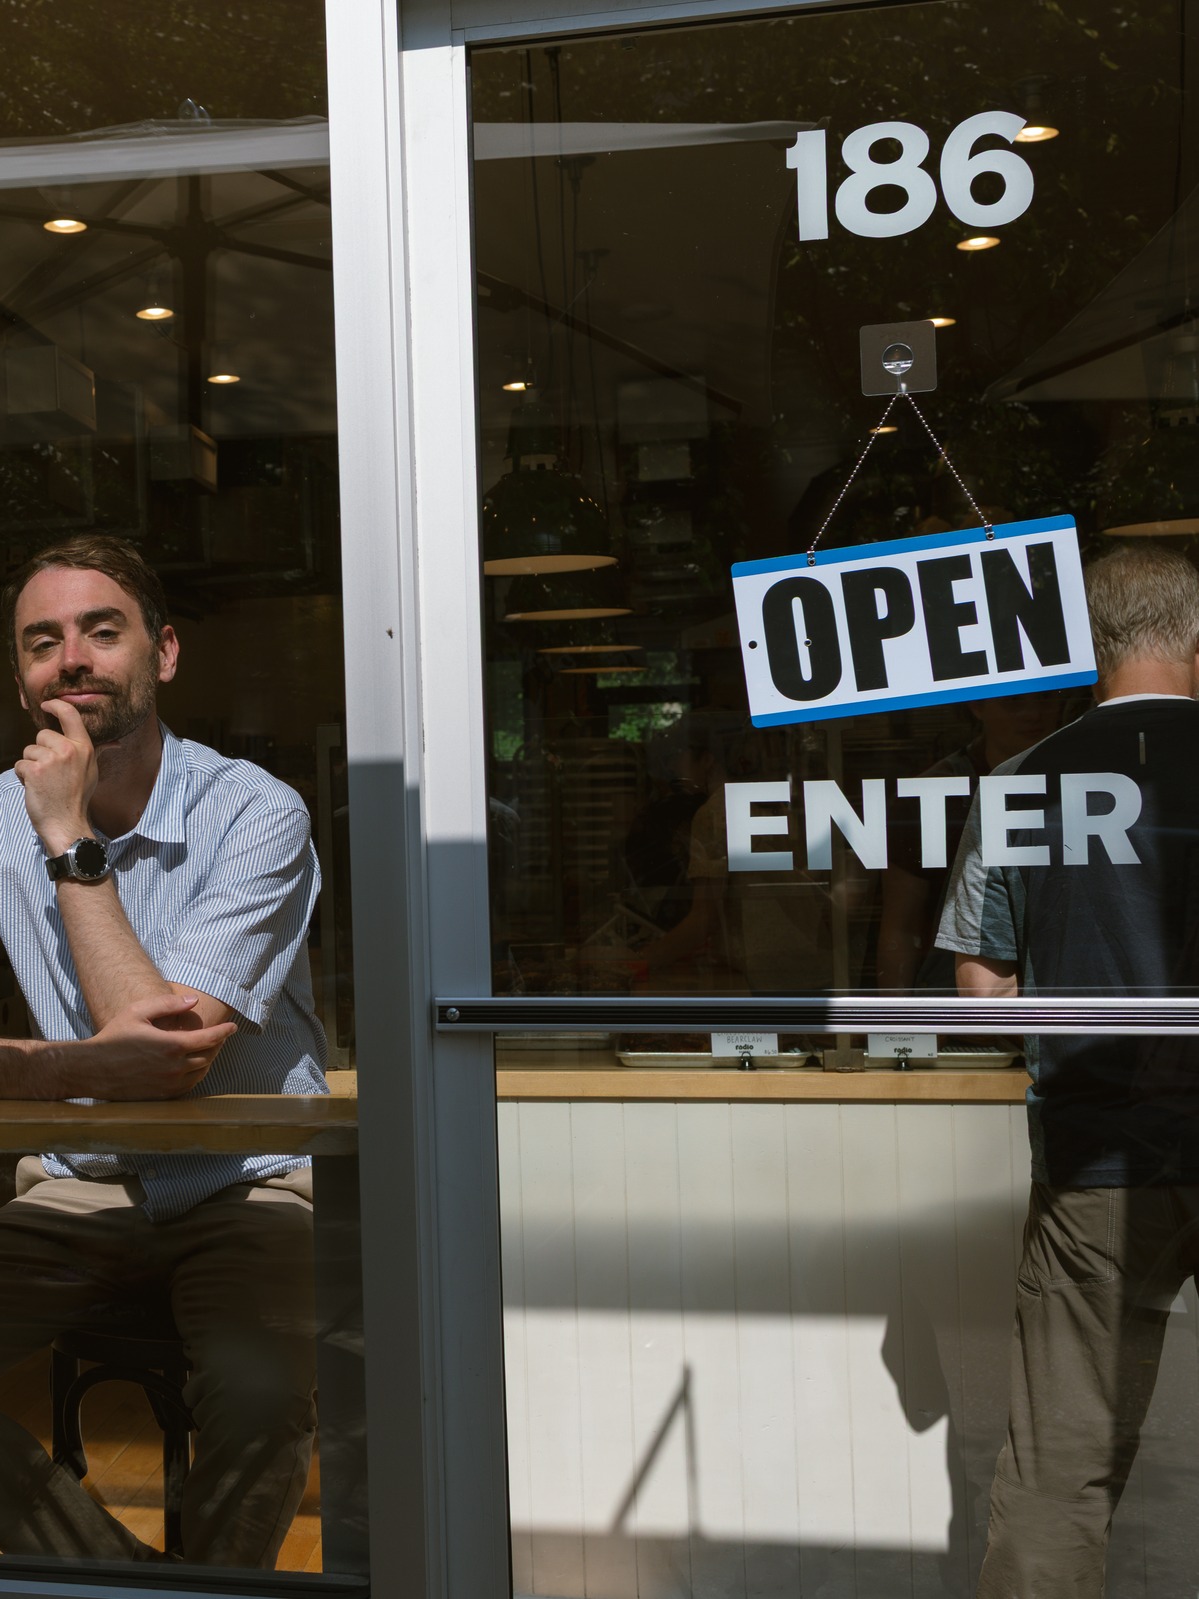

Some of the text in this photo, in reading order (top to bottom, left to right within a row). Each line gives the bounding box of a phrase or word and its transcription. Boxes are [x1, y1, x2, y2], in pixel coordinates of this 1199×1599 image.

[786, 110, 1035, 241] 186
[761, 541, 1071, 701] OPEN
[724, 772, 1142, 872] ENTER
